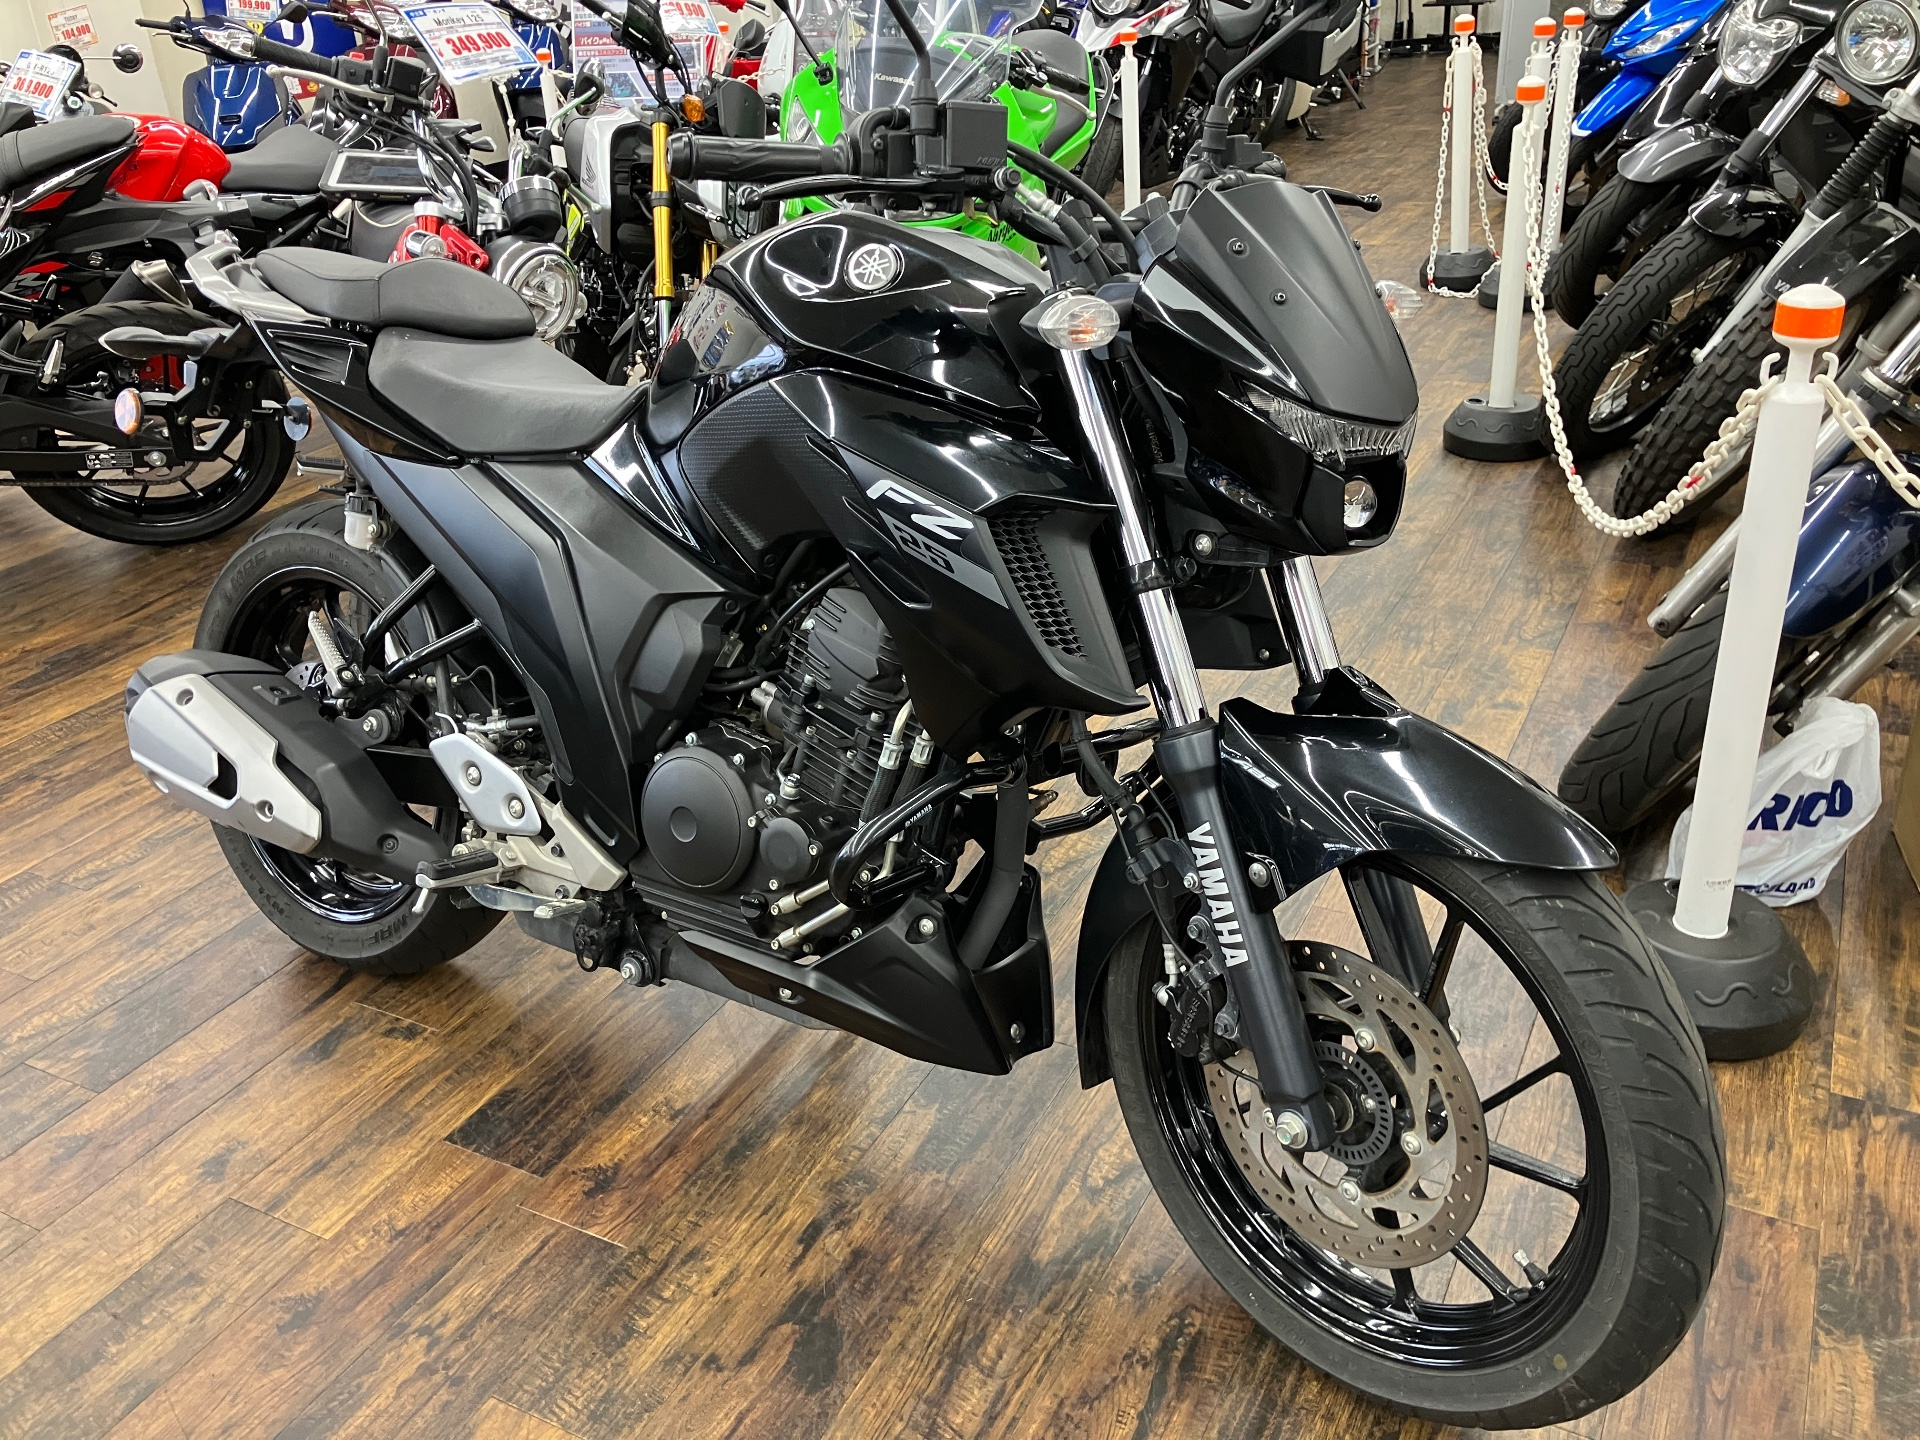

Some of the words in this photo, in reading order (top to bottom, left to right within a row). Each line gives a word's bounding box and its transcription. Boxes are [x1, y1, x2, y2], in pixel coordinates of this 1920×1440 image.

[239, 0, 270, 10] 199,900
[433, 14, 465, 26] Monkey
[466, 13, 485, 23] 125
[445, 31, 511, 56] 349,900
[13, 77, 54, 99] 369,900
[875, 72, 915, 87] Kawask
[866, 479, 975, 540] FZ
[893, 523, 955, 574] 25
[910, 803, 933, 824] YAMAHA
[1747, 779, 1853, 831] RICO
[1187, 821, 1249, 968] YAMAHA
